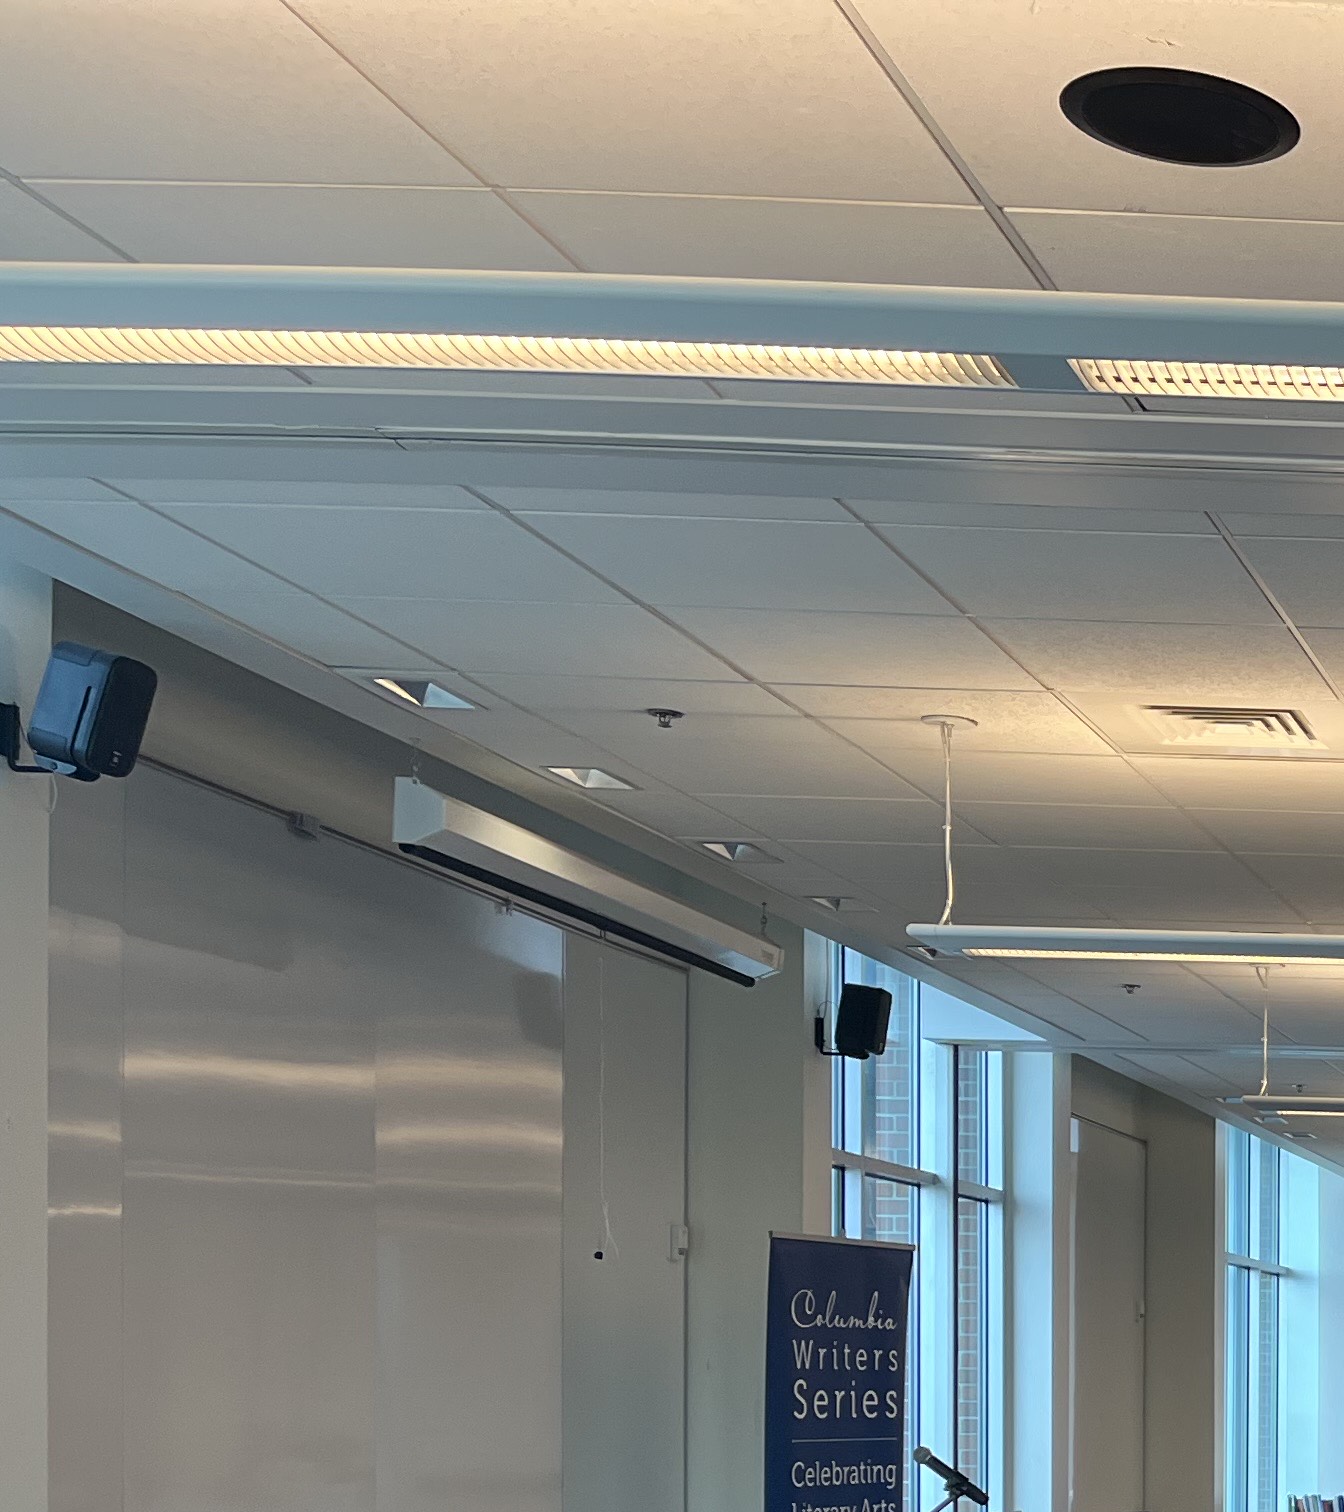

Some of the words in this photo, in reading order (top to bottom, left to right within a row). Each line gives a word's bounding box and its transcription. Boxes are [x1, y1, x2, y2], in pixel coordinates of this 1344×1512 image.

[791, 1289, 897, 1329] Columbia
[792, 1339, 898, 1371] Writers
[793, 1379, 898, 1419] Series
[791, 1460, 897, 1489] Celebrating
